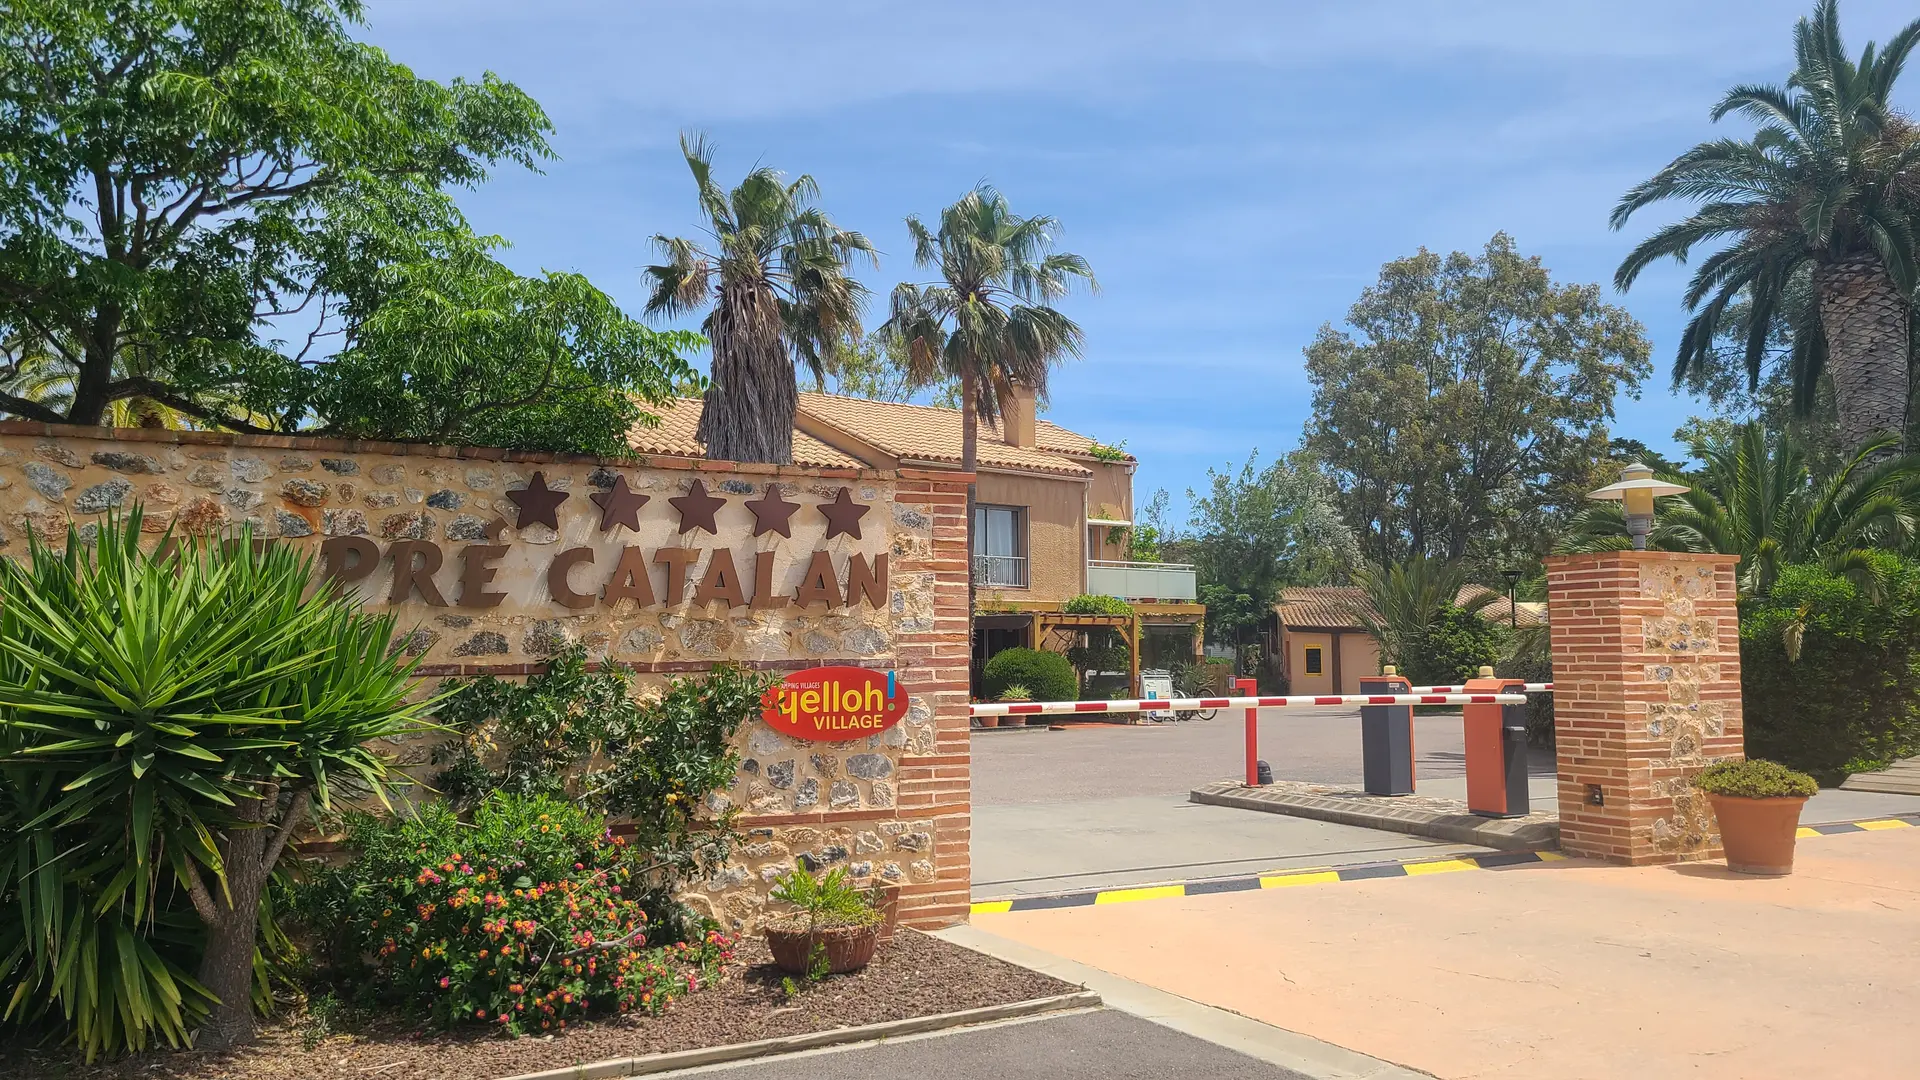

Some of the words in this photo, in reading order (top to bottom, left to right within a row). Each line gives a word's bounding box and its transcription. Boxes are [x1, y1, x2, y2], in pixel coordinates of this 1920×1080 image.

[321, 517, 511, 607] PRÉ
[547, 545, 889, 610] CATALAN
[778, 670, 896, 724] yelloh!
[813, 714, 884, 730] VILLAGE
